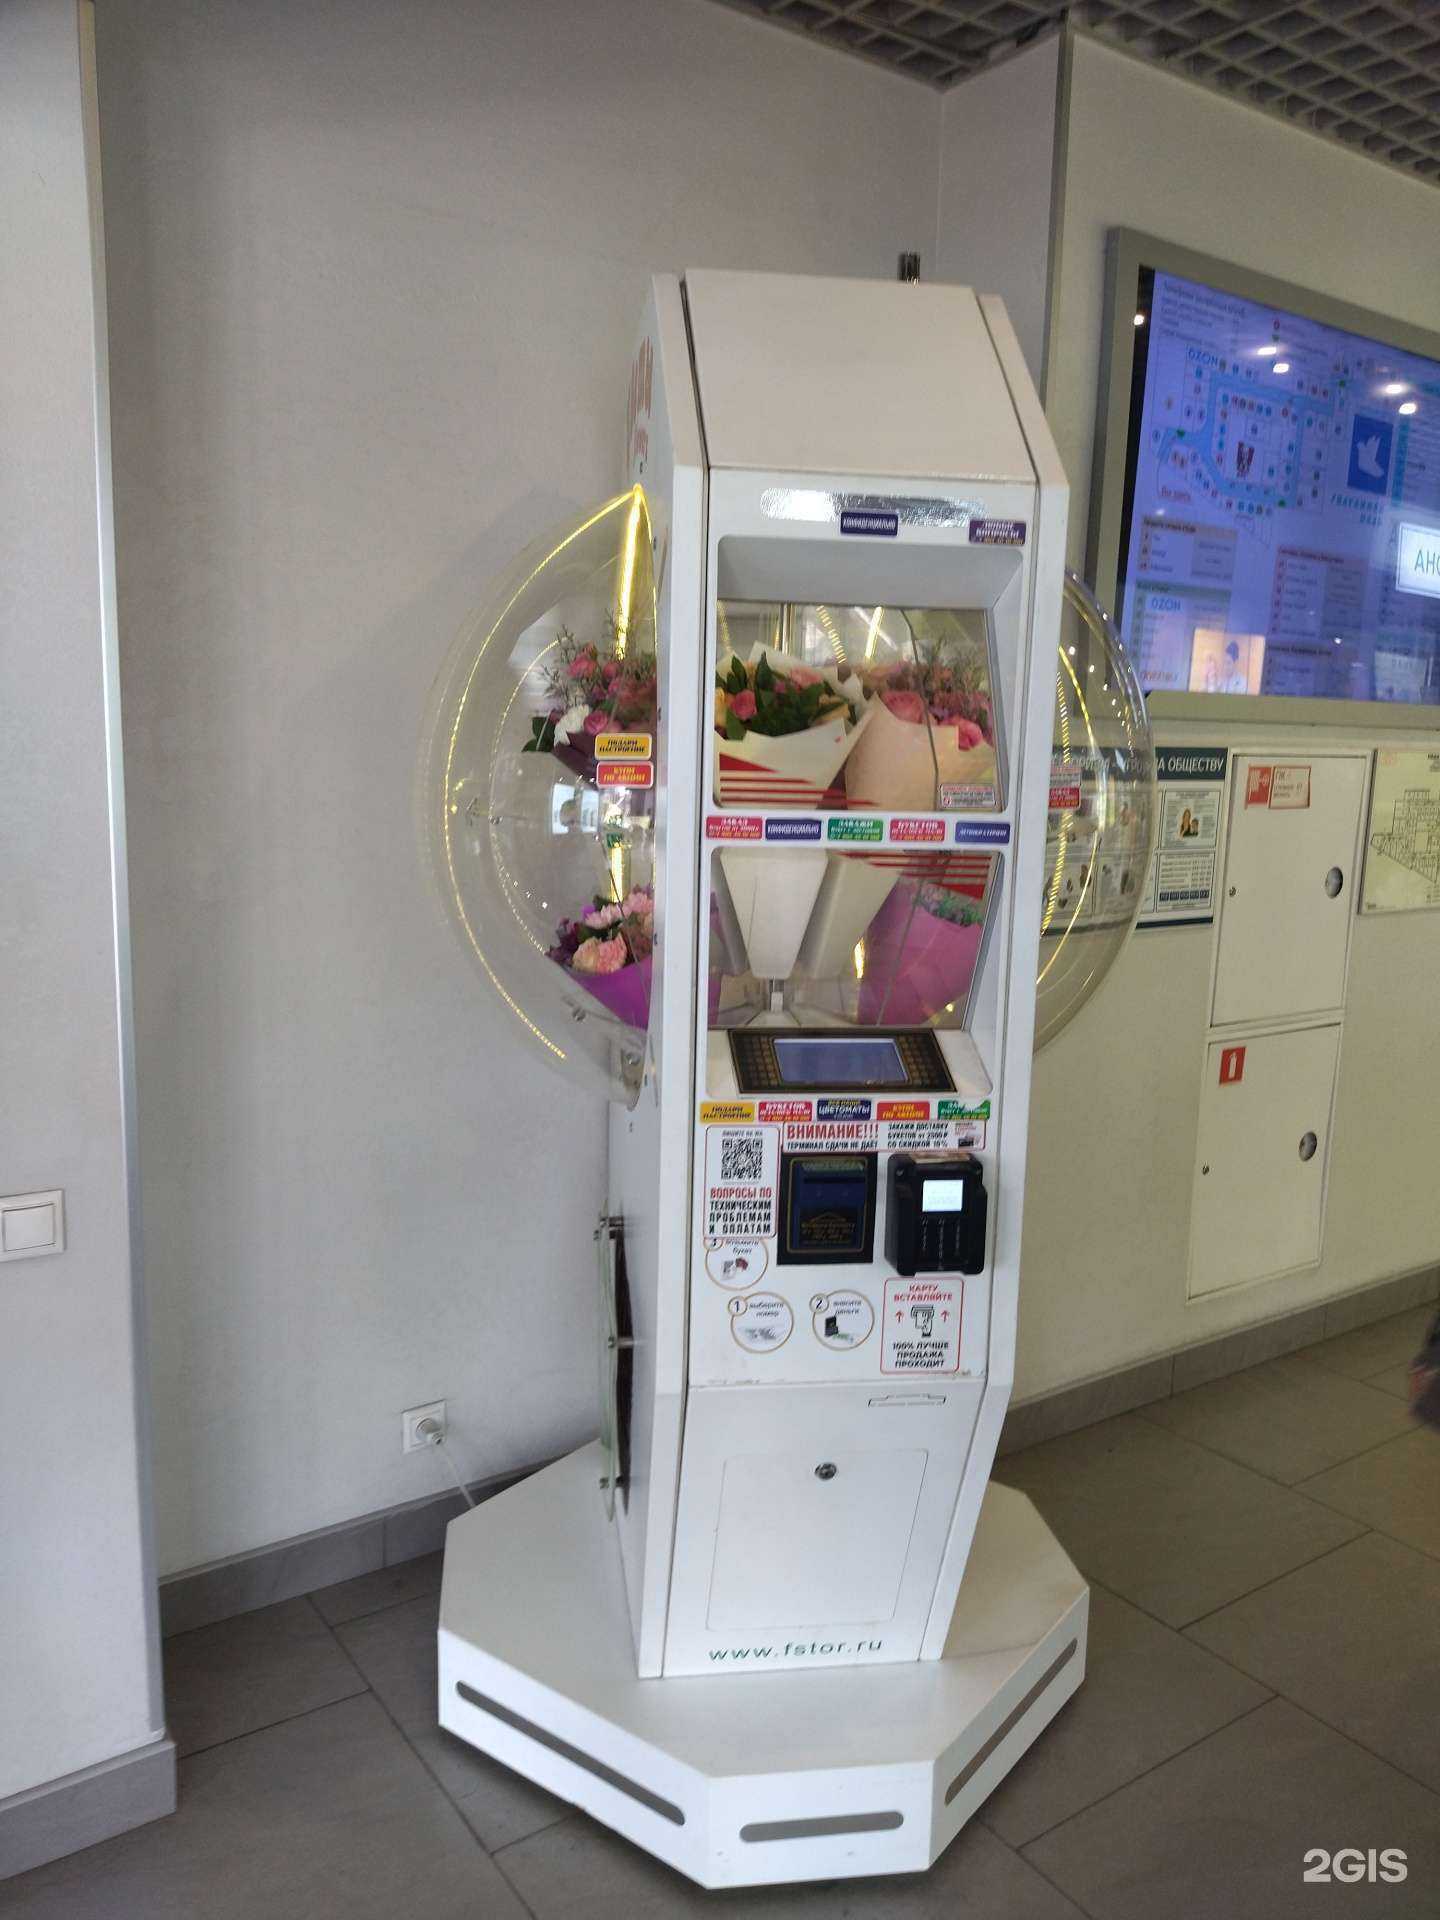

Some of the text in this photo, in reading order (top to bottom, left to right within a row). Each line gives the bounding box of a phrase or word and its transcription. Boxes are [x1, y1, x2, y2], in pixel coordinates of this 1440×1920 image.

[1168, 756, 1223, 774] ОБЩЕСТВУ
[819, 1104, 870, 1115] ЦВЕТОМАТЫ
[787, 1122, 879, 1140] ВНИМАНИЕ!!!
[787, 1140, 823, 1150] ТЕРМИНАЛ
[825, 1140, 848, 1151] СДАЧИ
[850, 1140, 860, 1150] НЕ
[887, 1140, 898, 1149] СО
[899, 1140, 931, 1150] СКИДКОЙ
[710, 1186, 772, 1200] ВОПРОСЫ ПО
[709, 1199, 772, 1212] ТЕХНИЧЕСКИМ
[709, 1211, 772, 1224] ПРОБЛЕМАМ
[708, 1223, 771, 1235] И ОПЛАТАМ
[909, 1284, 939, 1293] КАРТУ
[734, 1300, 741, 1313] 1
[896, 1350, 944, 1360] ПРОДАЖА
[894, 1359, 945, 1369] ПРОХОДИТ
[708, 1638, 883, 1662] www.fstor.ru
